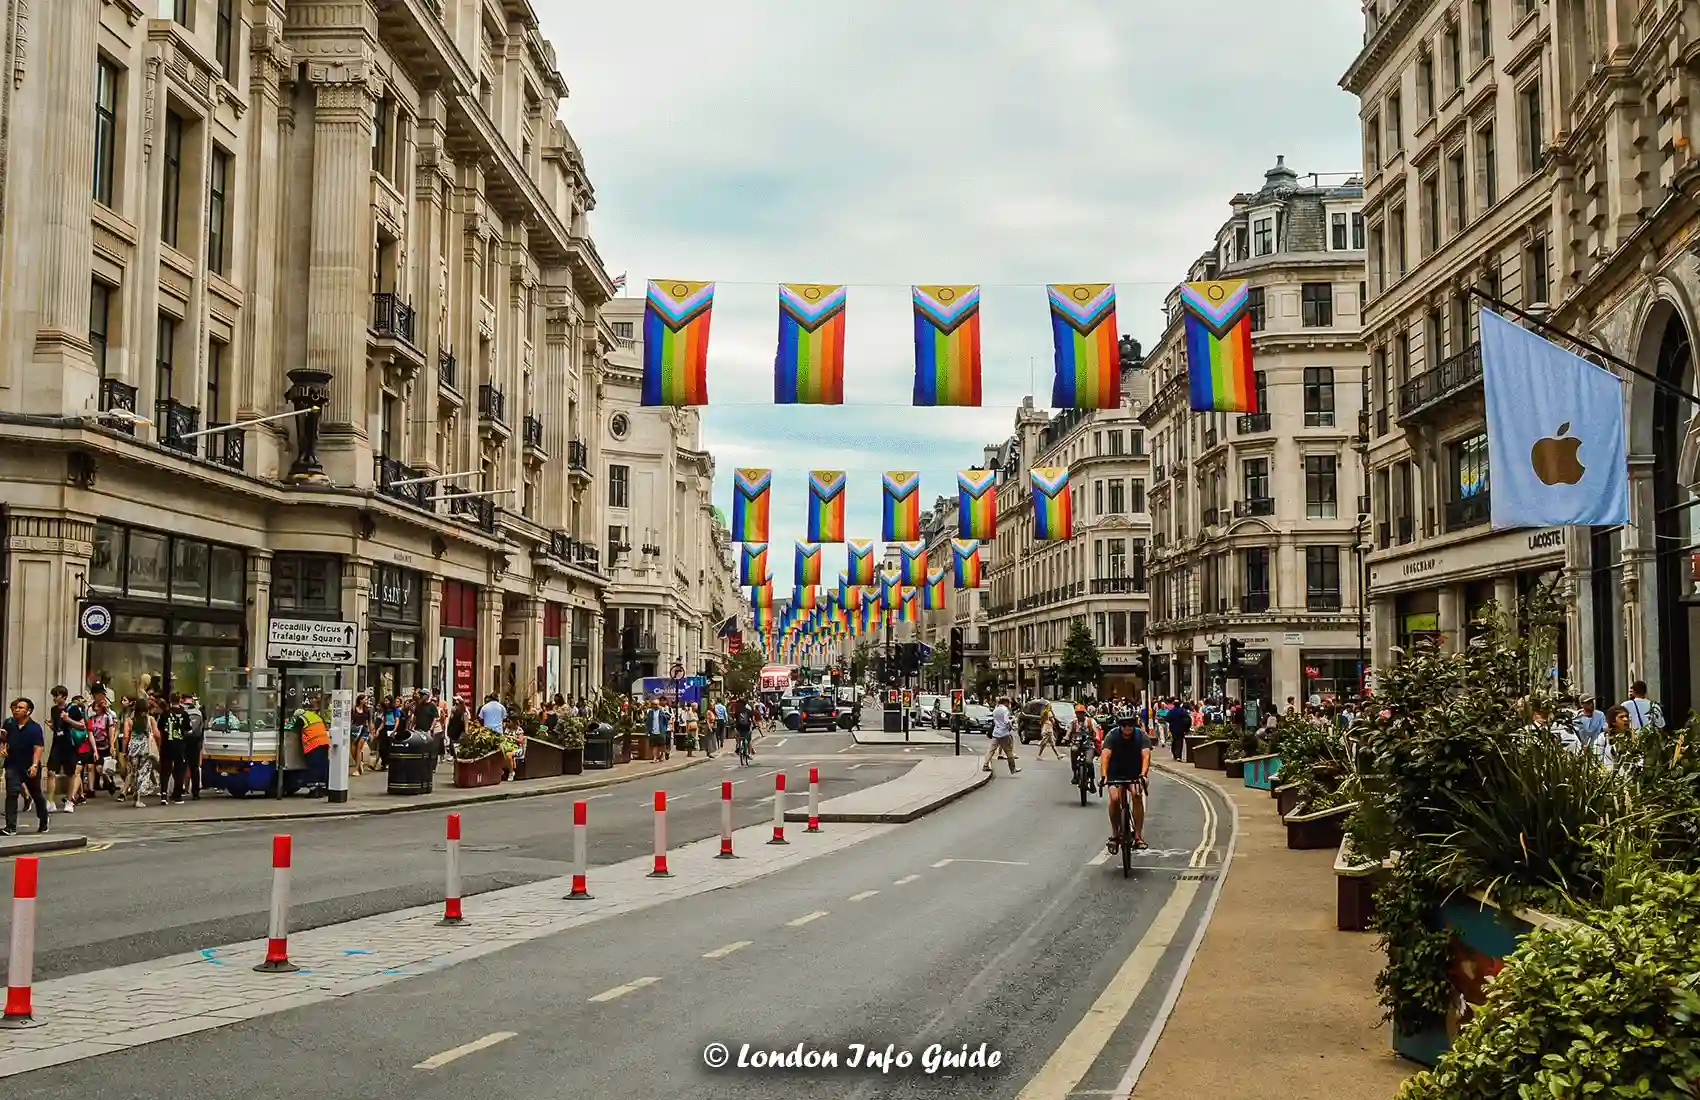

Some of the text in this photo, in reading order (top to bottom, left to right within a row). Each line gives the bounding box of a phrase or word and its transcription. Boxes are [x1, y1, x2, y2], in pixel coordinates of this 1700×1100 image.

[1528, 530, 1561, 550] LACOSTE
[1403, 558, 1436, 576] LONGCHAMP
[272, 621, 341, 633] Piccadilly Circus
[272, 632, 342, 643] Trafalgar Square
[280, 648, 331, 658] Marble Arch
